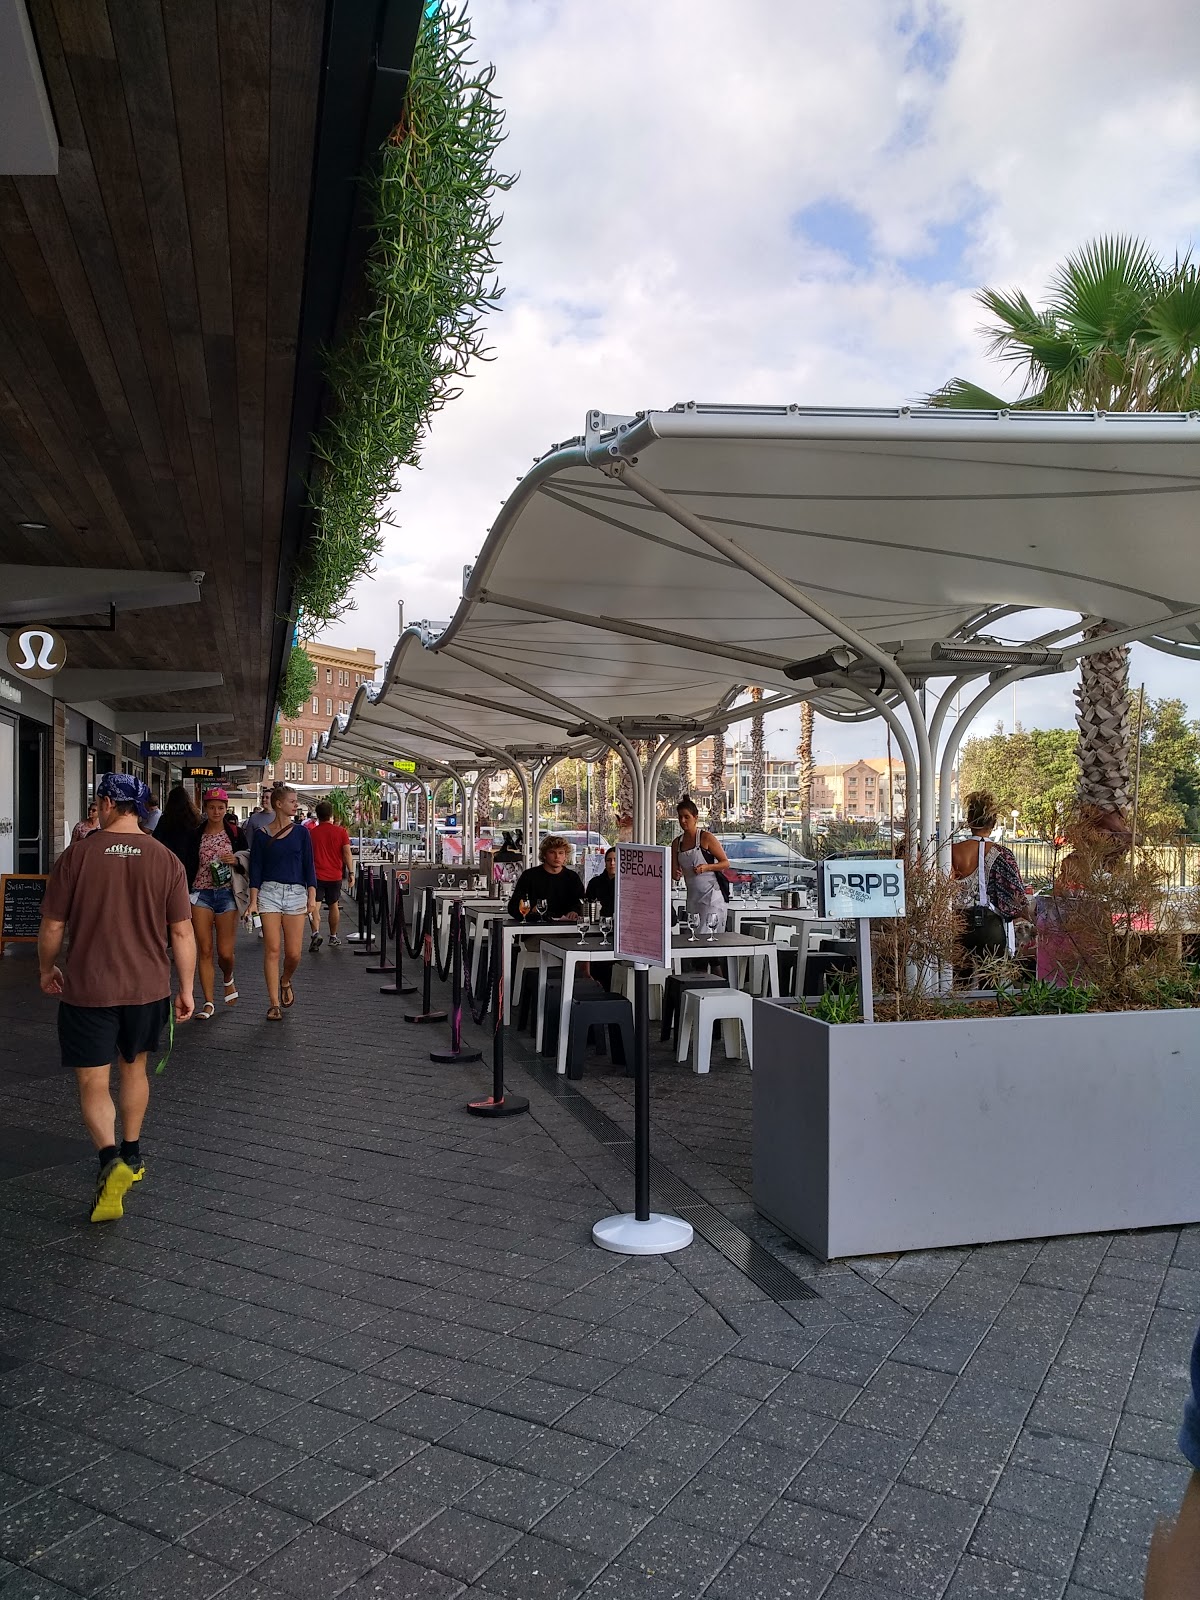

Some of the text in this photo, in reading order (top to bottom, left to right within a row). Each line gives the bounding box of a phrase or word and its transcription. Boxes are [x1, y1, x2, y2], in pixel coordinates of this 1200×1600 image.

[150, 743, 192, 752] BIRKENSTOCK
[190, 768, 214, 776] ANITA
[620, 849, 644, 863] BBPB
[620, 862, 662, 878] SPECIALS
[855, 890, 872, 901] BEACH
